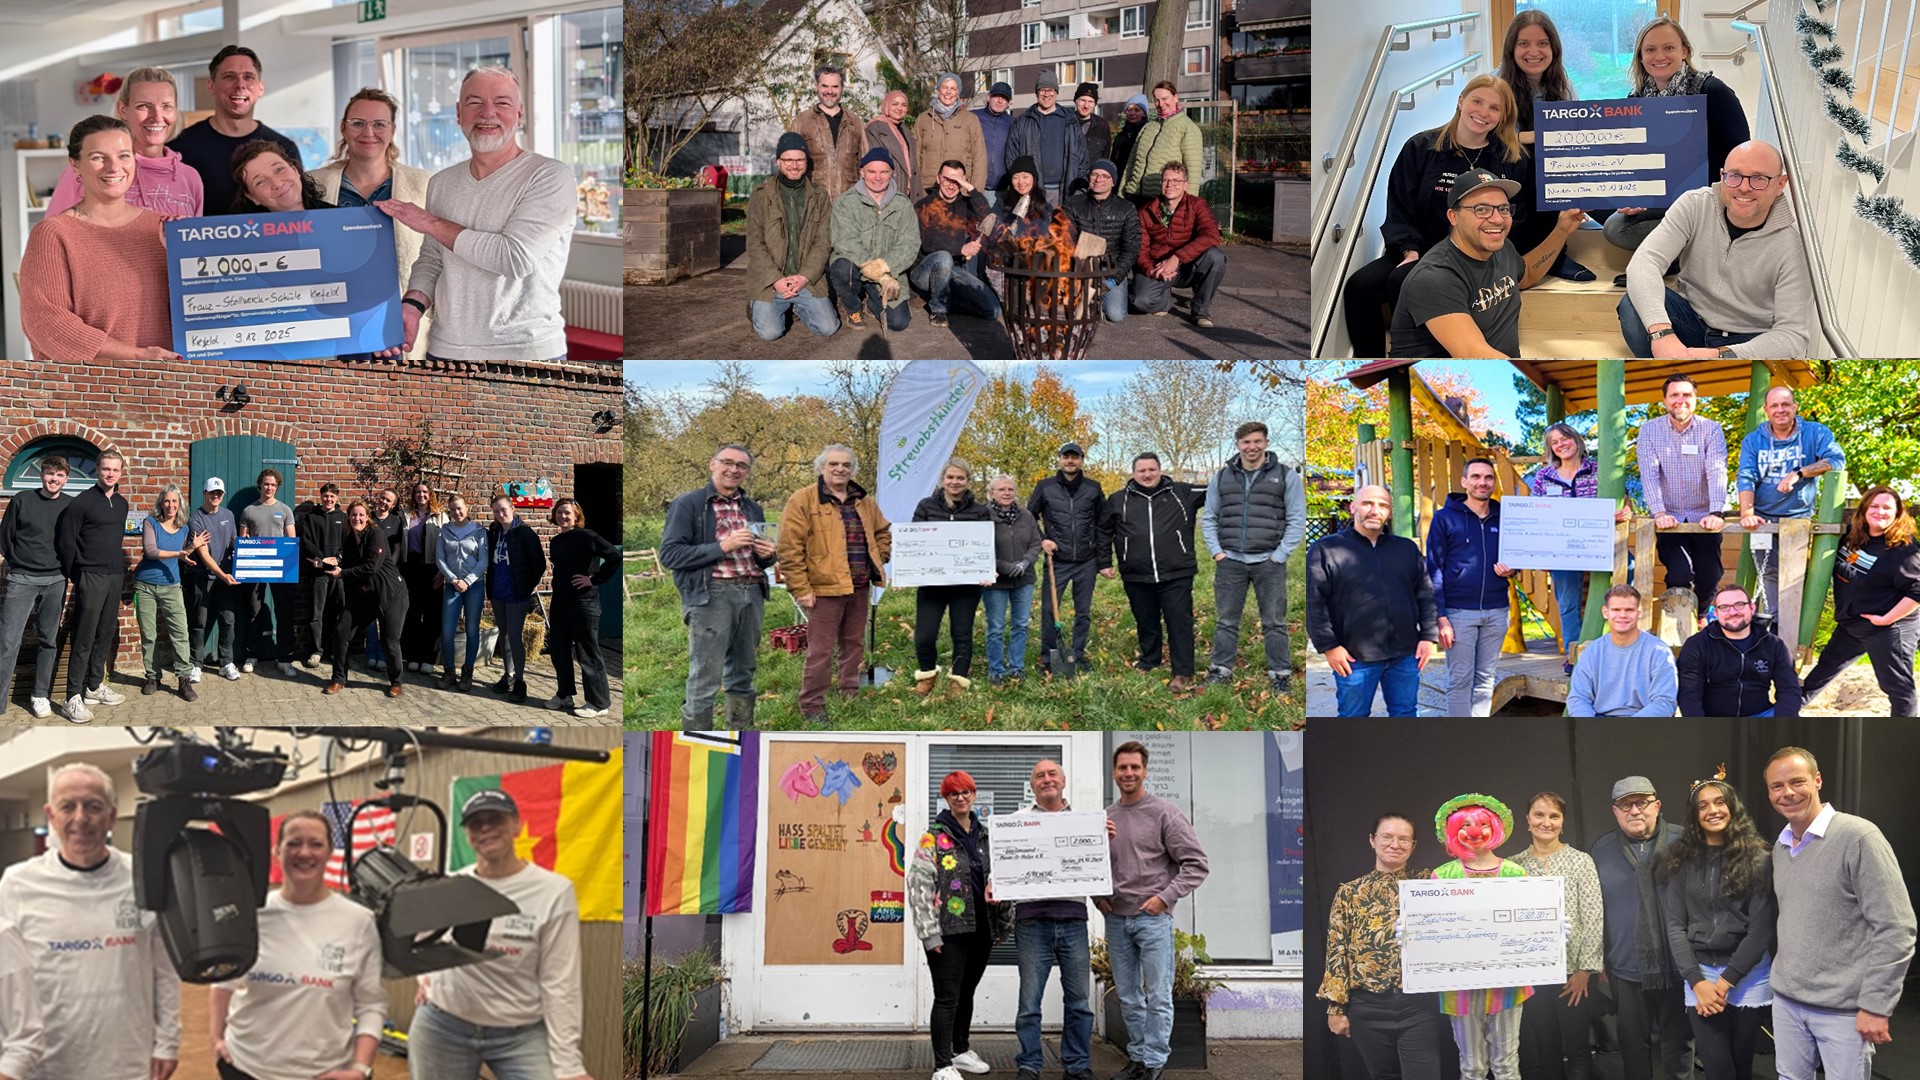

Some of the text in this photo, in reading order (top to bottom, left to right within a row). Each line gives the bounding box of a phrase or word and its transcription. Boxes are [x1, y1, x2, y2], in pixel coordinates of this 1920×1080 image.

[1542, 106, 1643, 119] TARGO BANK
[178, 220, 314, 242] TARGO BANK
[343, 224, 382, 232] Spendenscheck
[276, 255, 288, 270] €
[265, 327, 295, 341] 2025
[888, 381, 967, 481] Streuobstkinder
[1758, 446, 1806, 463] REBEL
[778, 824, 846, 839] HASS SPALTET
[778, 837, 806, 849] LIEBE
[873, 914, 902, 922] HAPPY
[48, 936, 136, 951] TARGO BANK
[301, 975, 334, 989] BANK
